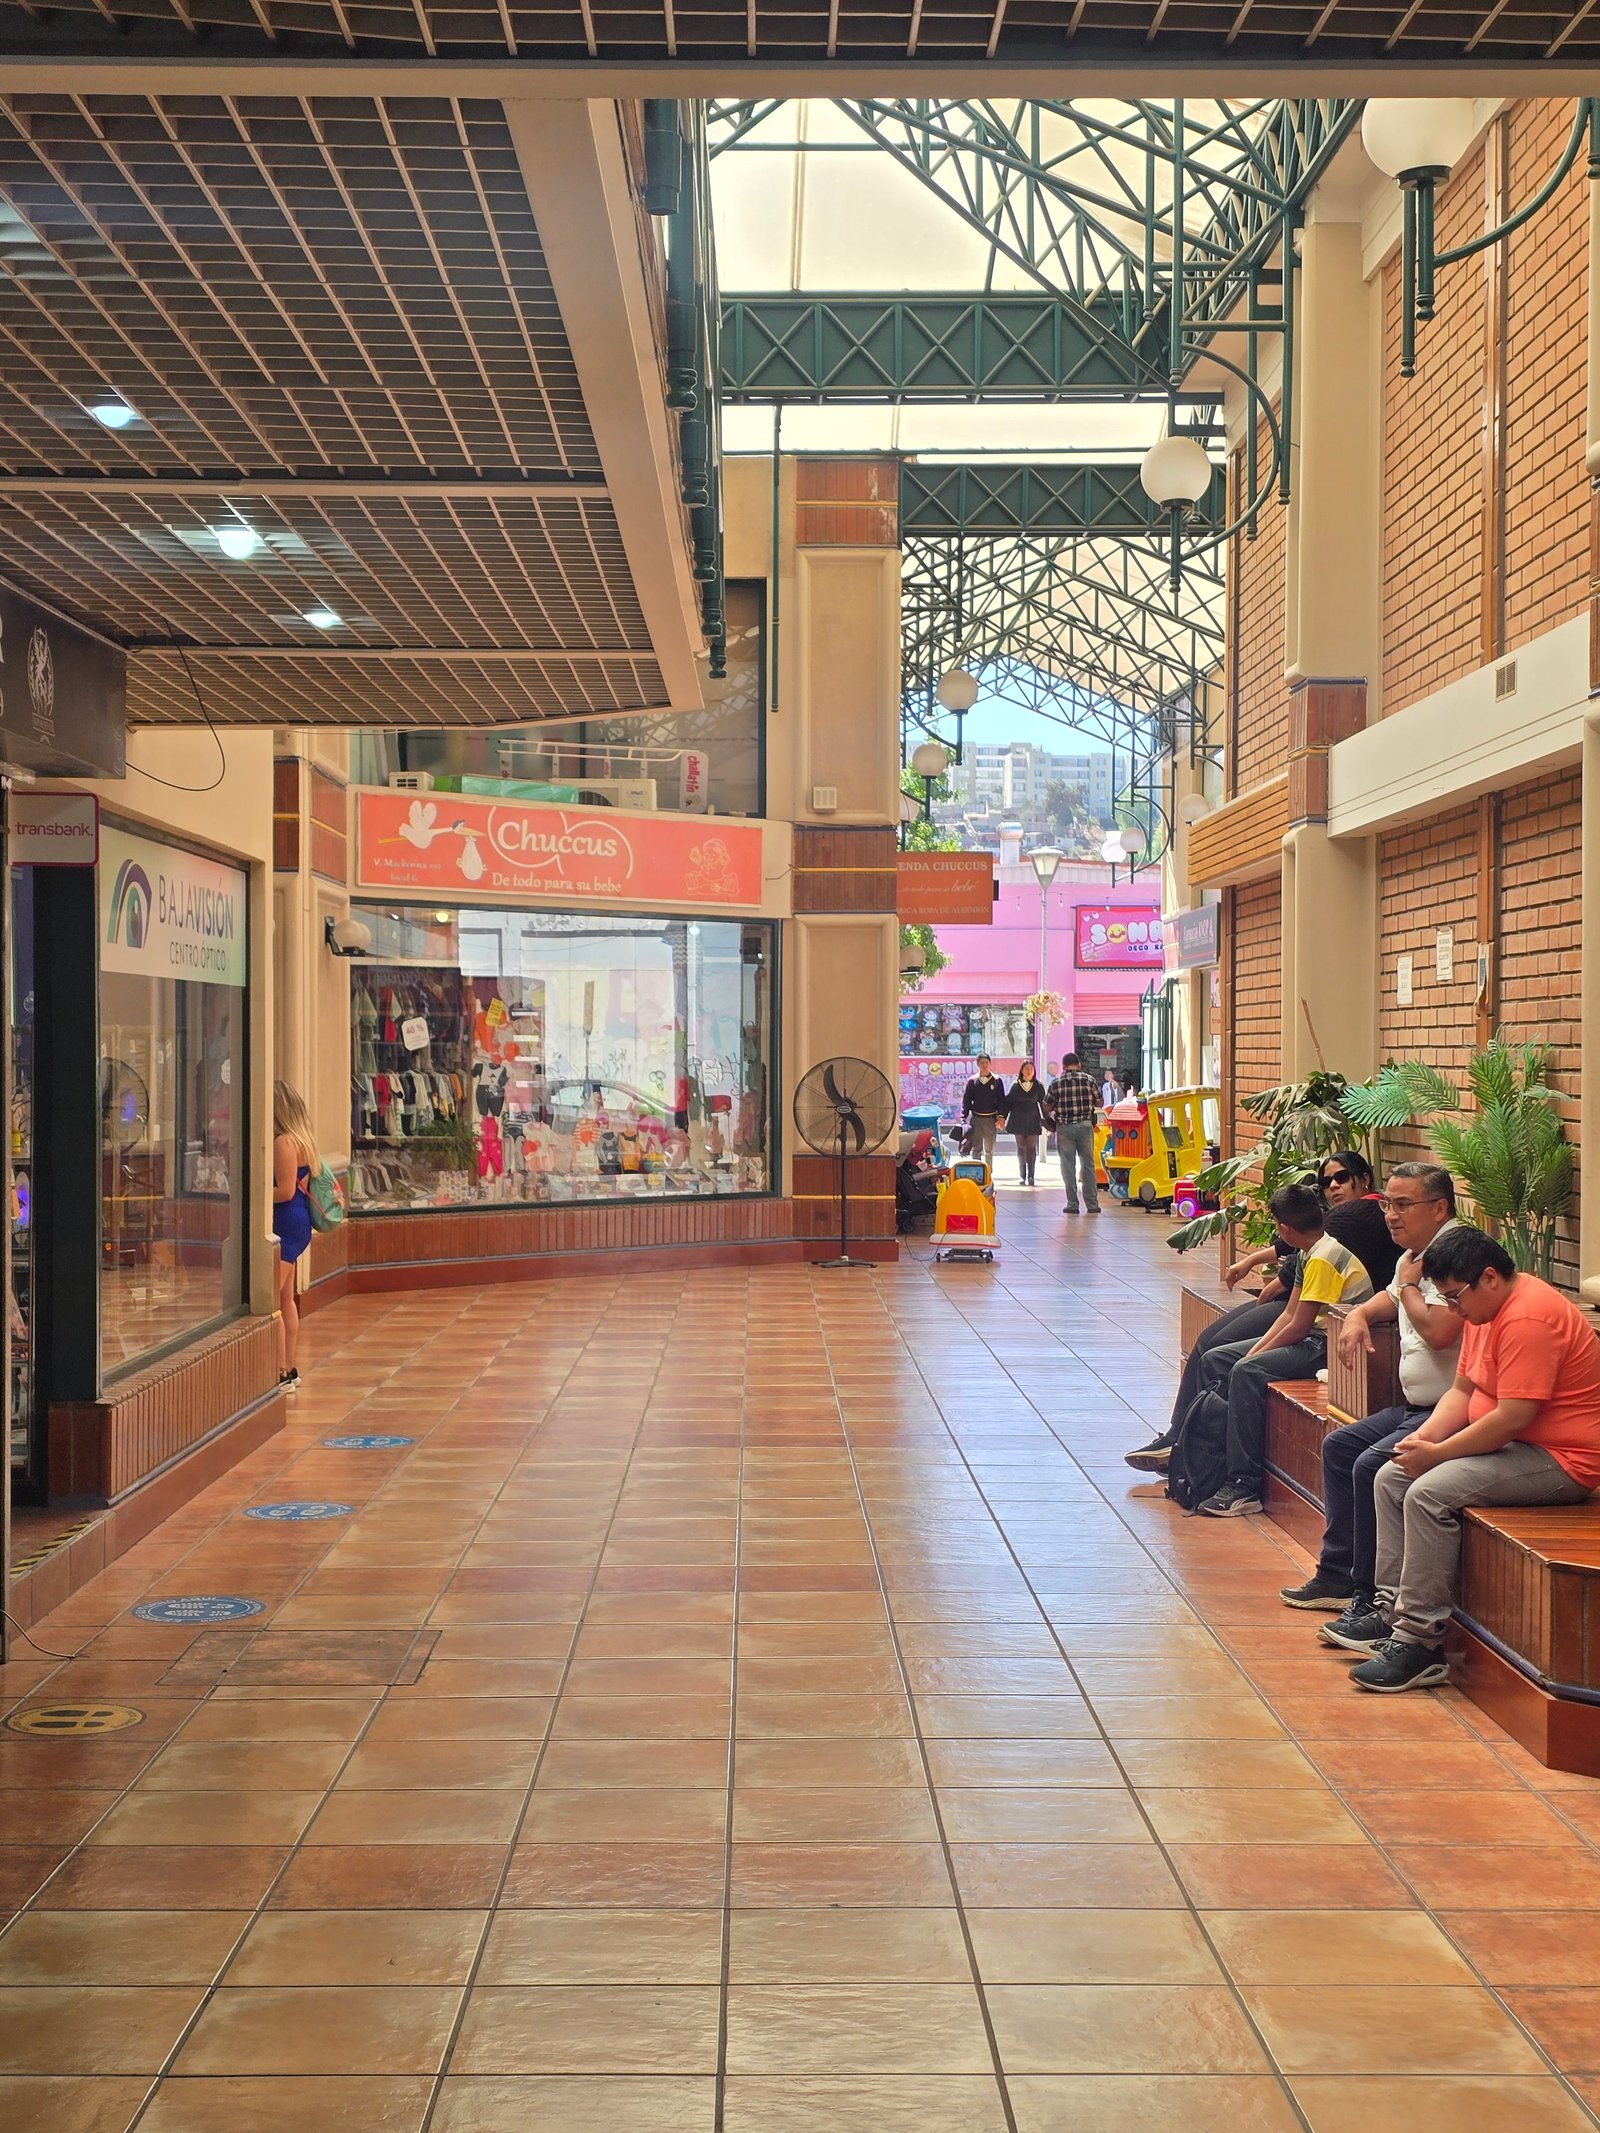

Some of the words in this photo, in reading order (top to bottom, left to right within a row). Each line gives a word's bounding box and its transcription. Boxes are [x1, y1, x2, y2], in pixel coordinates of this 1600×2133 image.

[497, 818, 618, 858] Chuccus
[897, 862, 930, 871] ENDA
[932, 861, 988, 871] CHUCCUS
[491, 872, 511, 886] De
[512, 872, 542, 888] todo
[544, 878, 574, 891] para
[576, 881, 591, 891] su
[593, 876, 622, 893] bebe
[158, 874, 235, 940] BAJAVISIÓN
[169, 941, 199, 969] CENTRO
[200, 942, 227, 971] ÓPTICO
[1128, 945, 1149, 953] DECO
